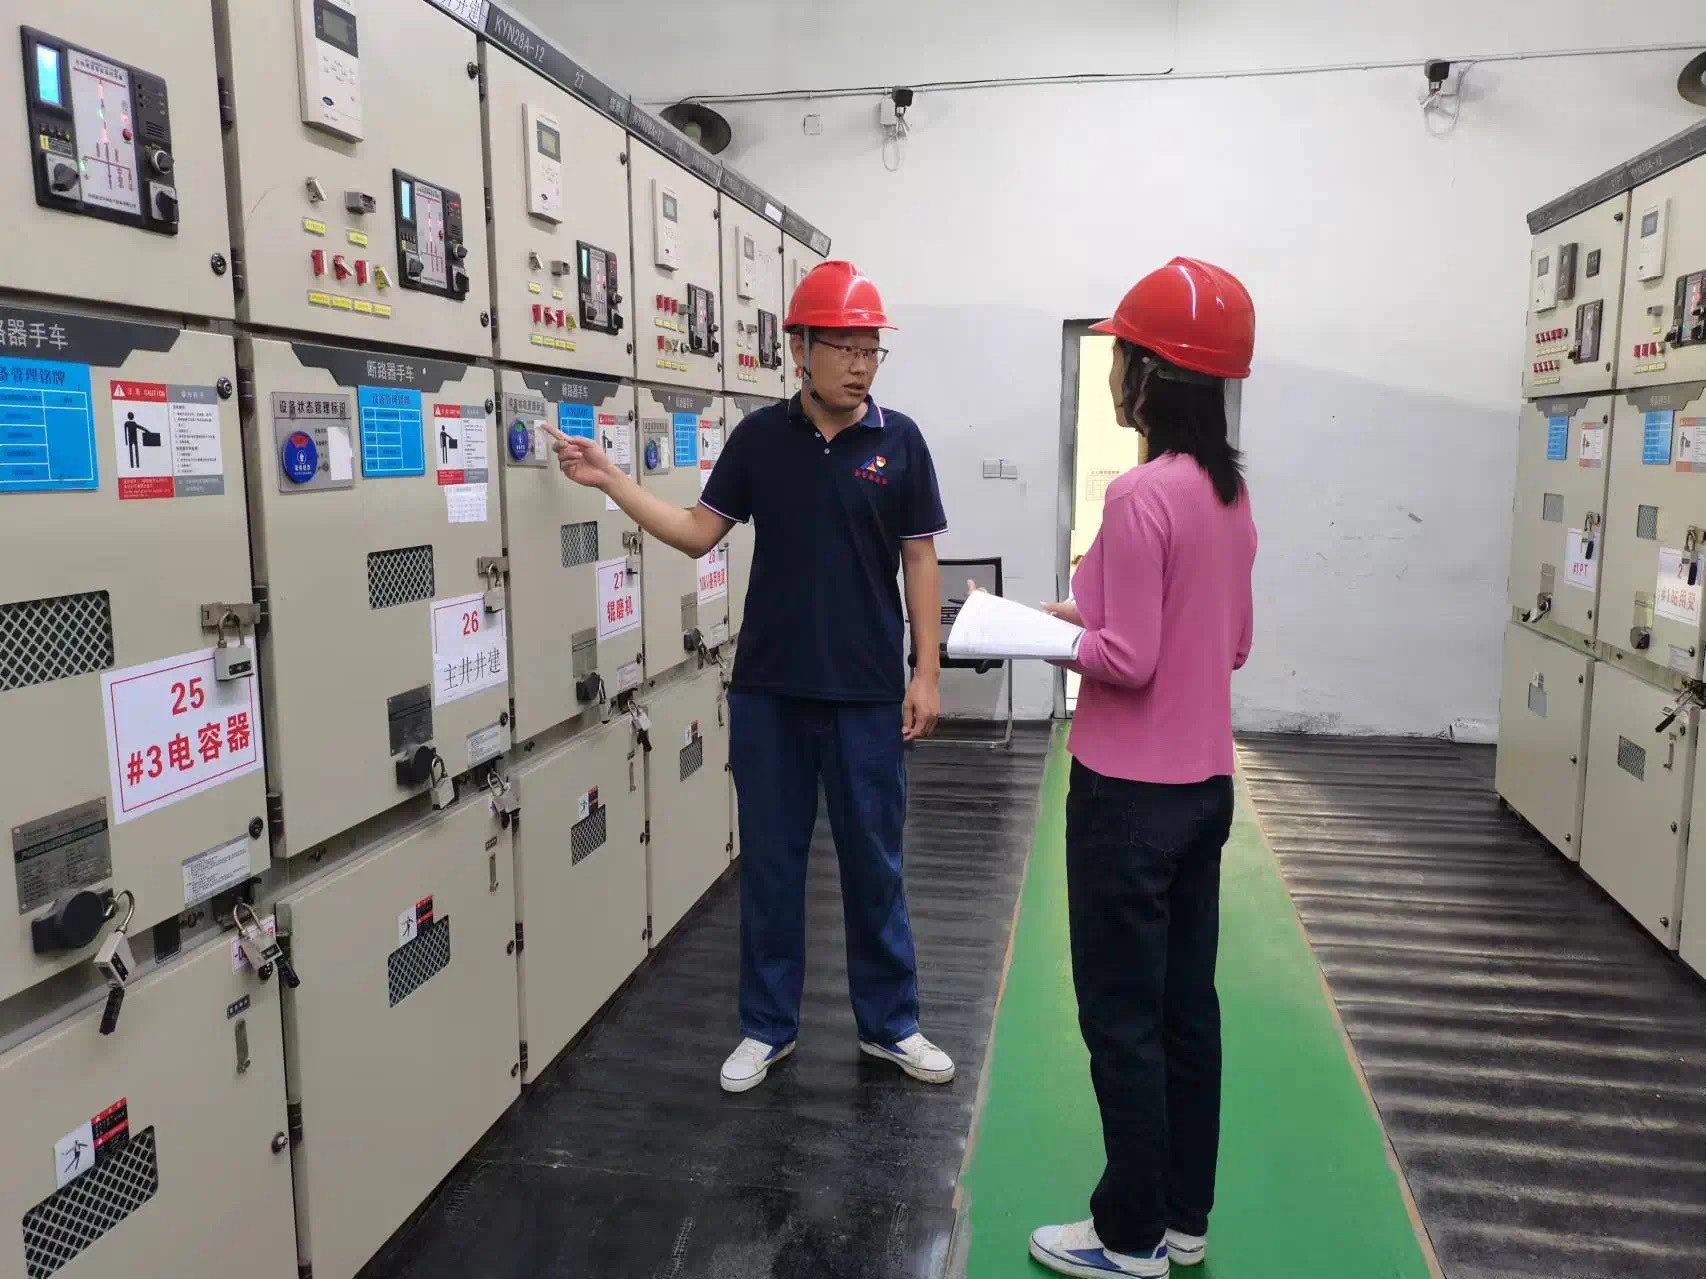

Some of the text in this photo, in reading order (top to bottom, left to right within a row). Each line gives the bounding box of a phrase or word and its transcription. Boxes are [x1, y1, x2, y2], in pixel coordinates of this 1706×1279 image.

[494, 14, 546, 63] KYN28A-12
[0, 318, 69, 350] 器手车
[366, 359, 415, 382] 断路器手车
[280, 400, 346, 415] 设备状态管理标识
[613, 571, 624, 590] 27
[462, 610, 479, 635] 26
[443, 647, 501, 691] 主井井建
[171, 676, 205, 716] 25
[127, 711, 251, 787] #3电容器
